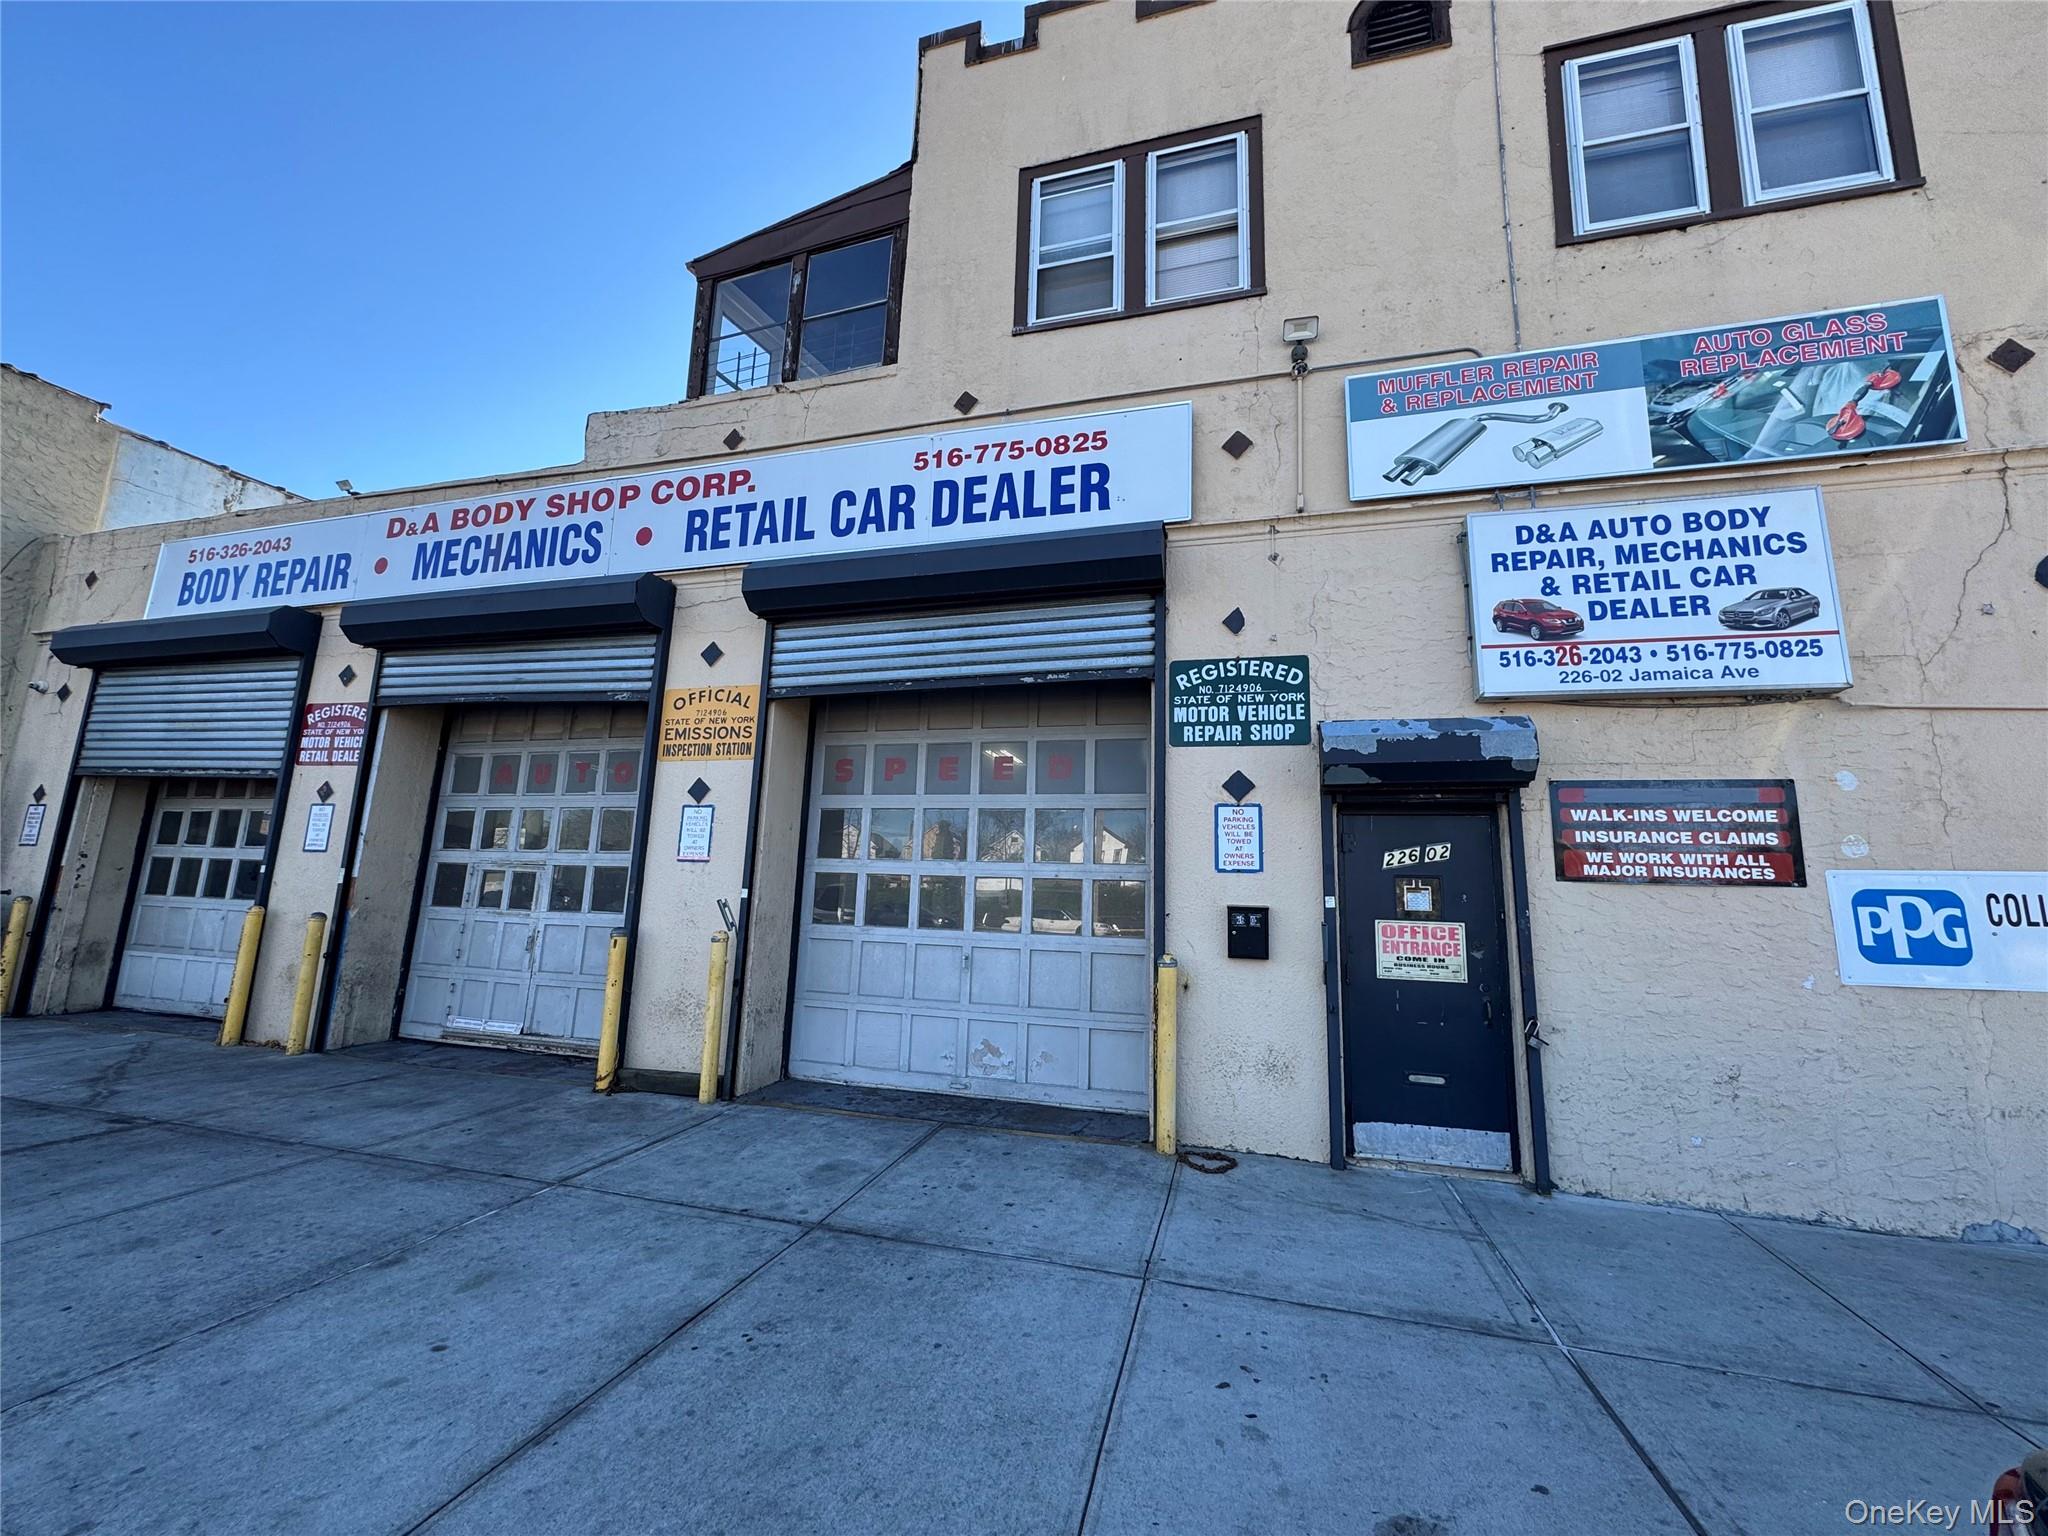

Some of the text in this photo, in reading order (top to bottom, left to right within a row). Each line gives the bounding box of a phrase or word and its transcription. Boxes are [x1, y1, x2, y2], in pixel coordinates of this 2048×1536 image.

[1694, 314, 1889, 355] AUTO GLASS
[1680, 332, 1908, 378] REPLACEMENT
[1377, 351, 1599, 396] MUFFLER REPAIR
[1381, 372, 1596, 414] & REPLACEMENT
[913, 431, 1108, 471] 516-775-0825
[386, 470, 756, 539] D&A BODY SHOP CORP.
[684, 463, 1111, 553] RETAIL CAR DEALER
[1515, 506, 1771, 545] D&A AUTO BODY
[188, 537, 291, 564] 516-326-2043
[412, 520, 603, 580] MECHANICS
[1491, 532, 1808, 572] REPAIR, MECHANICS
[177, 552, 352, 607] BODY REPAIR
[1540, 564, 1757, 596] & RETAIL CAR
[1588, 595, 1711, 621] DEALER
[1499, 639, 1823, 668] 516-326-2043 516-775-0825
[1176, 660, 1303, 690] REGISTERED
[1559, 664, 1759, 684] 226-02 Jamaica Ave
[673, 689, 751, 710] OFFICIAL
[1174, 693, 1305, 704] STATE OF NEW YORK
[1199, 683, 1262, 694] NO. 7124906
[307, 705, 367, 725] REGISTERE
[1174, 704, 1305, 722] MOTOR VEHICLE
[301, 737, 330, 748] MOTOR
[664, 726, 753, 741] EMISSIONS
[1183, 724, 1295, 741] REPAIR SHOP
[299, 751, 328, 761] RETAIL
[662, 742, 752, 757] INSPECTION STATION
[495, 762, 633, 785] AUTO
[834, 756, 1072, 782] SPEED
[1570, 809, 1779, 822] WALK-INS WELCOME
[1575, 831, 1779, 845] INSURANCE CLAIMS
[1386, 845, 1449, 867] 226 02
[1586, 852, 1770, 866] WE WORK WITH ALL
[1583, 865, 1776, 880] MAJOR INSURANCES
[1381, 924, 1460, 941] OFFICE
[1856, 895, 1968, 959] PPG
[1382, 940, 1461, 957] ENTRANCE
